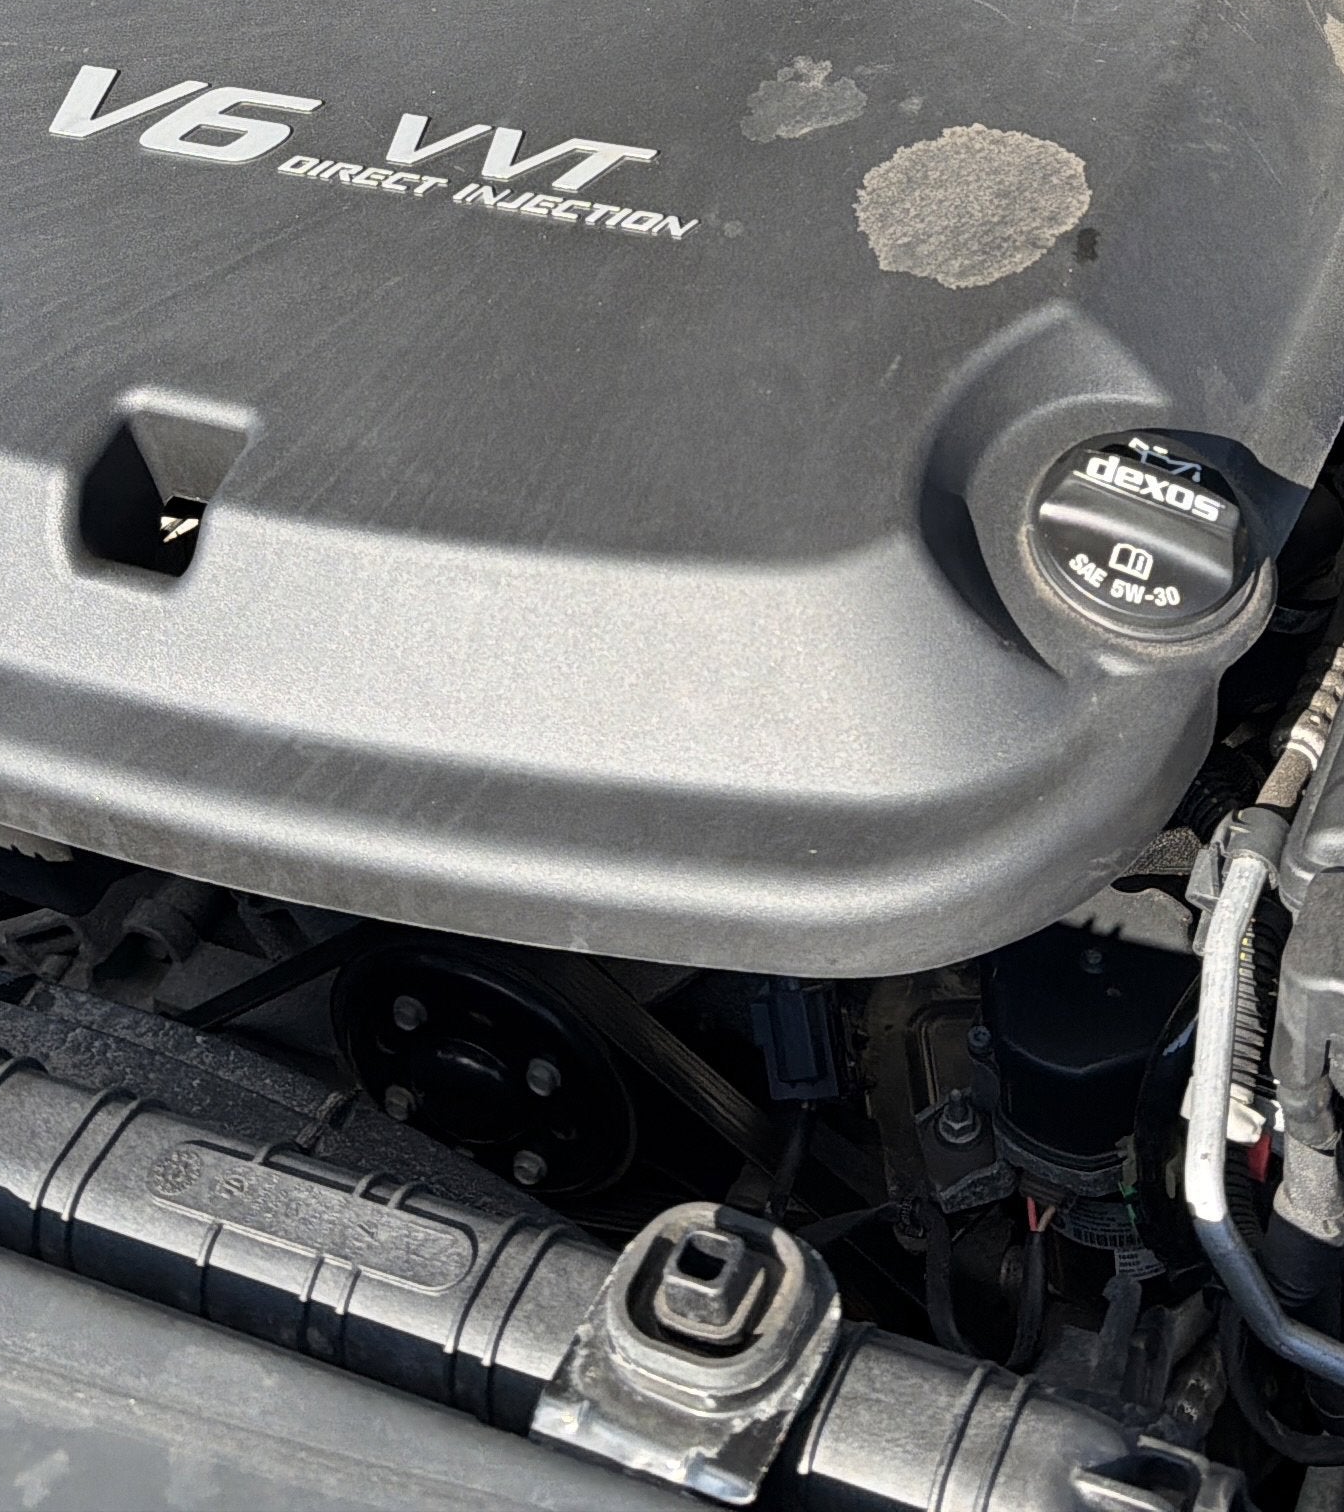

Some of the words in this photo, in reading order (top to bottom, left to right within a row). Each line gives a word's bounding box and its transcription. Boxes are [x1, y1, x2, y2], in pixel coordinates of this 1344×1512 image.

[49, 64, 323, 164] V6
[385, 113, 658, 191] VVT
[277, 155, 449, 196] DIRECT
[453, 182, 699, 239] INJECTION
[1086, 455, 1224, 522] dexos
[1068, 552, 1108, 589] SAE
[1110, 578, 1181, 607] 5W-30
